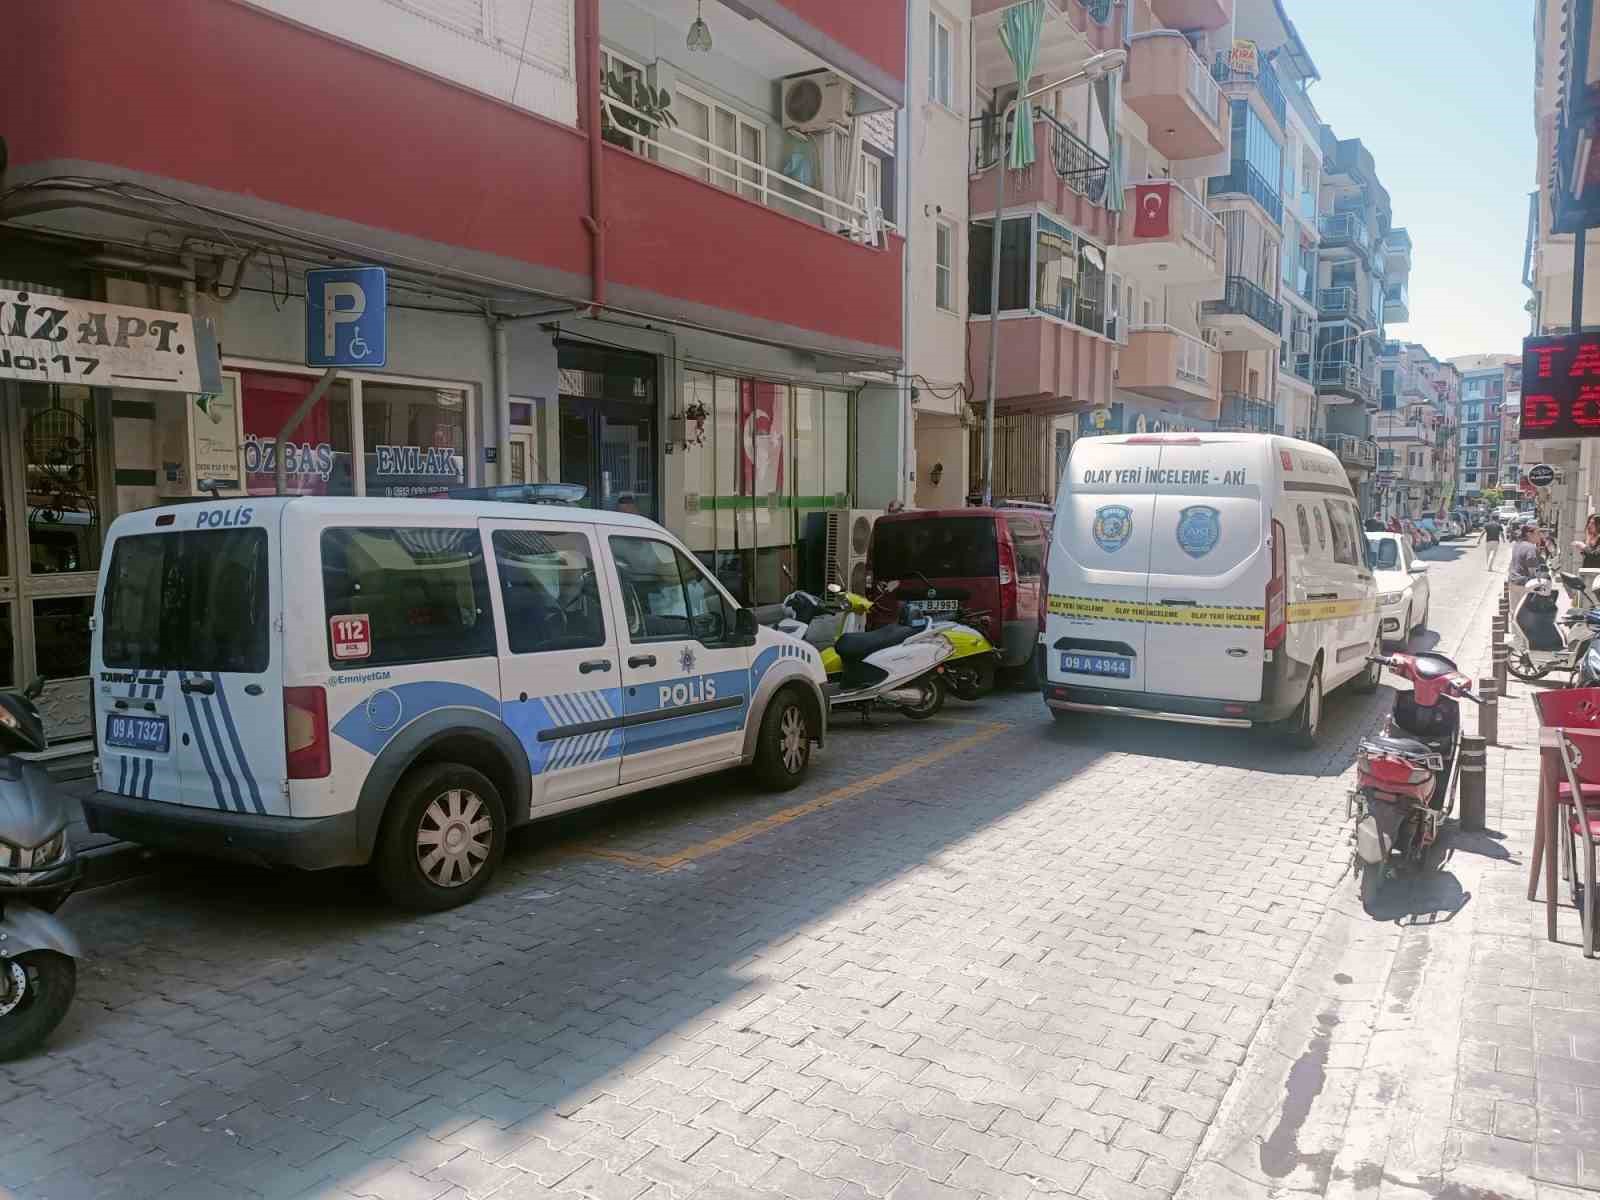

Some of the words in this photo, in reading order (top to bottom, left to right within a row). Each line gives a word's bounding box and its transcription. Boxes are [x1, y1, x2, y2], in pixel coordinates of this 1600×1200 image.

[77, 312, 185, 355] APT.
[324, 283, 367, 357] P
[244, 434, 333, 481] ÖZBAŞ
[376, 445, 457, 475] EMLAK
[1084, 469, 1112, 484] OLAY
[1115, 466, 1141, 484] YERİ
[1145, 466, 1209, 485] İNCELEME
[1223, 467, 1246, 486] AKİ
[196, 504, 253, 528] POLİS
[338, 621, 364, 641] 112
[1064, 656, 1080, 669] 09
[1084, 658, 1092, 669] A
[1095, 659, 1126, 673] 4944
[659, 675, 717, 708] POLİS
[113, 719, 125, 738] 09
[126, 720, 135, 739] A
[136, 720, 165, 742] 7327
